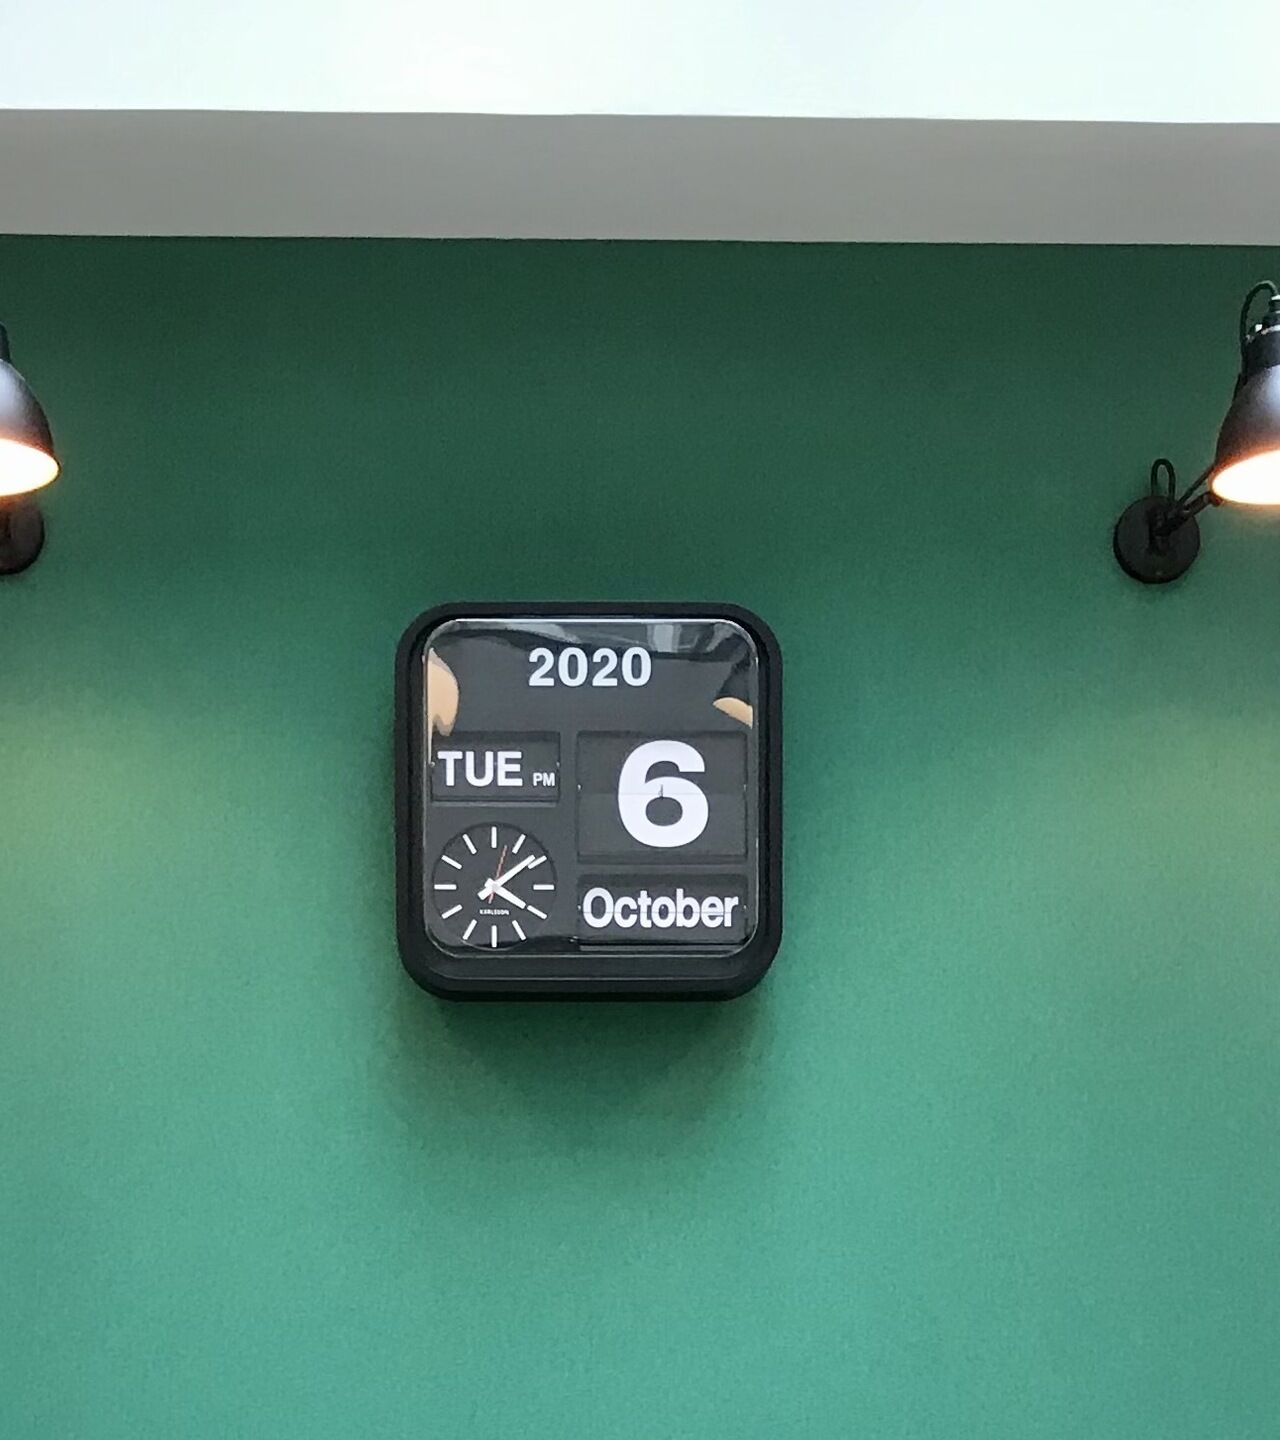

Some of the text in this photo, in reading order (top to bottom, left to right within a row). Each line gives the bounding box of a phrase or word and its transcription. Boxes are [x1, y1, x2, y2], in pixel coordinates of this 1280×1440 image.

[528, 647, 652, 687] 2020
[437, 750, 555, 787] TUE PM
[618, 740, 709, 848] 6
[582, 887, 739, 928] October
